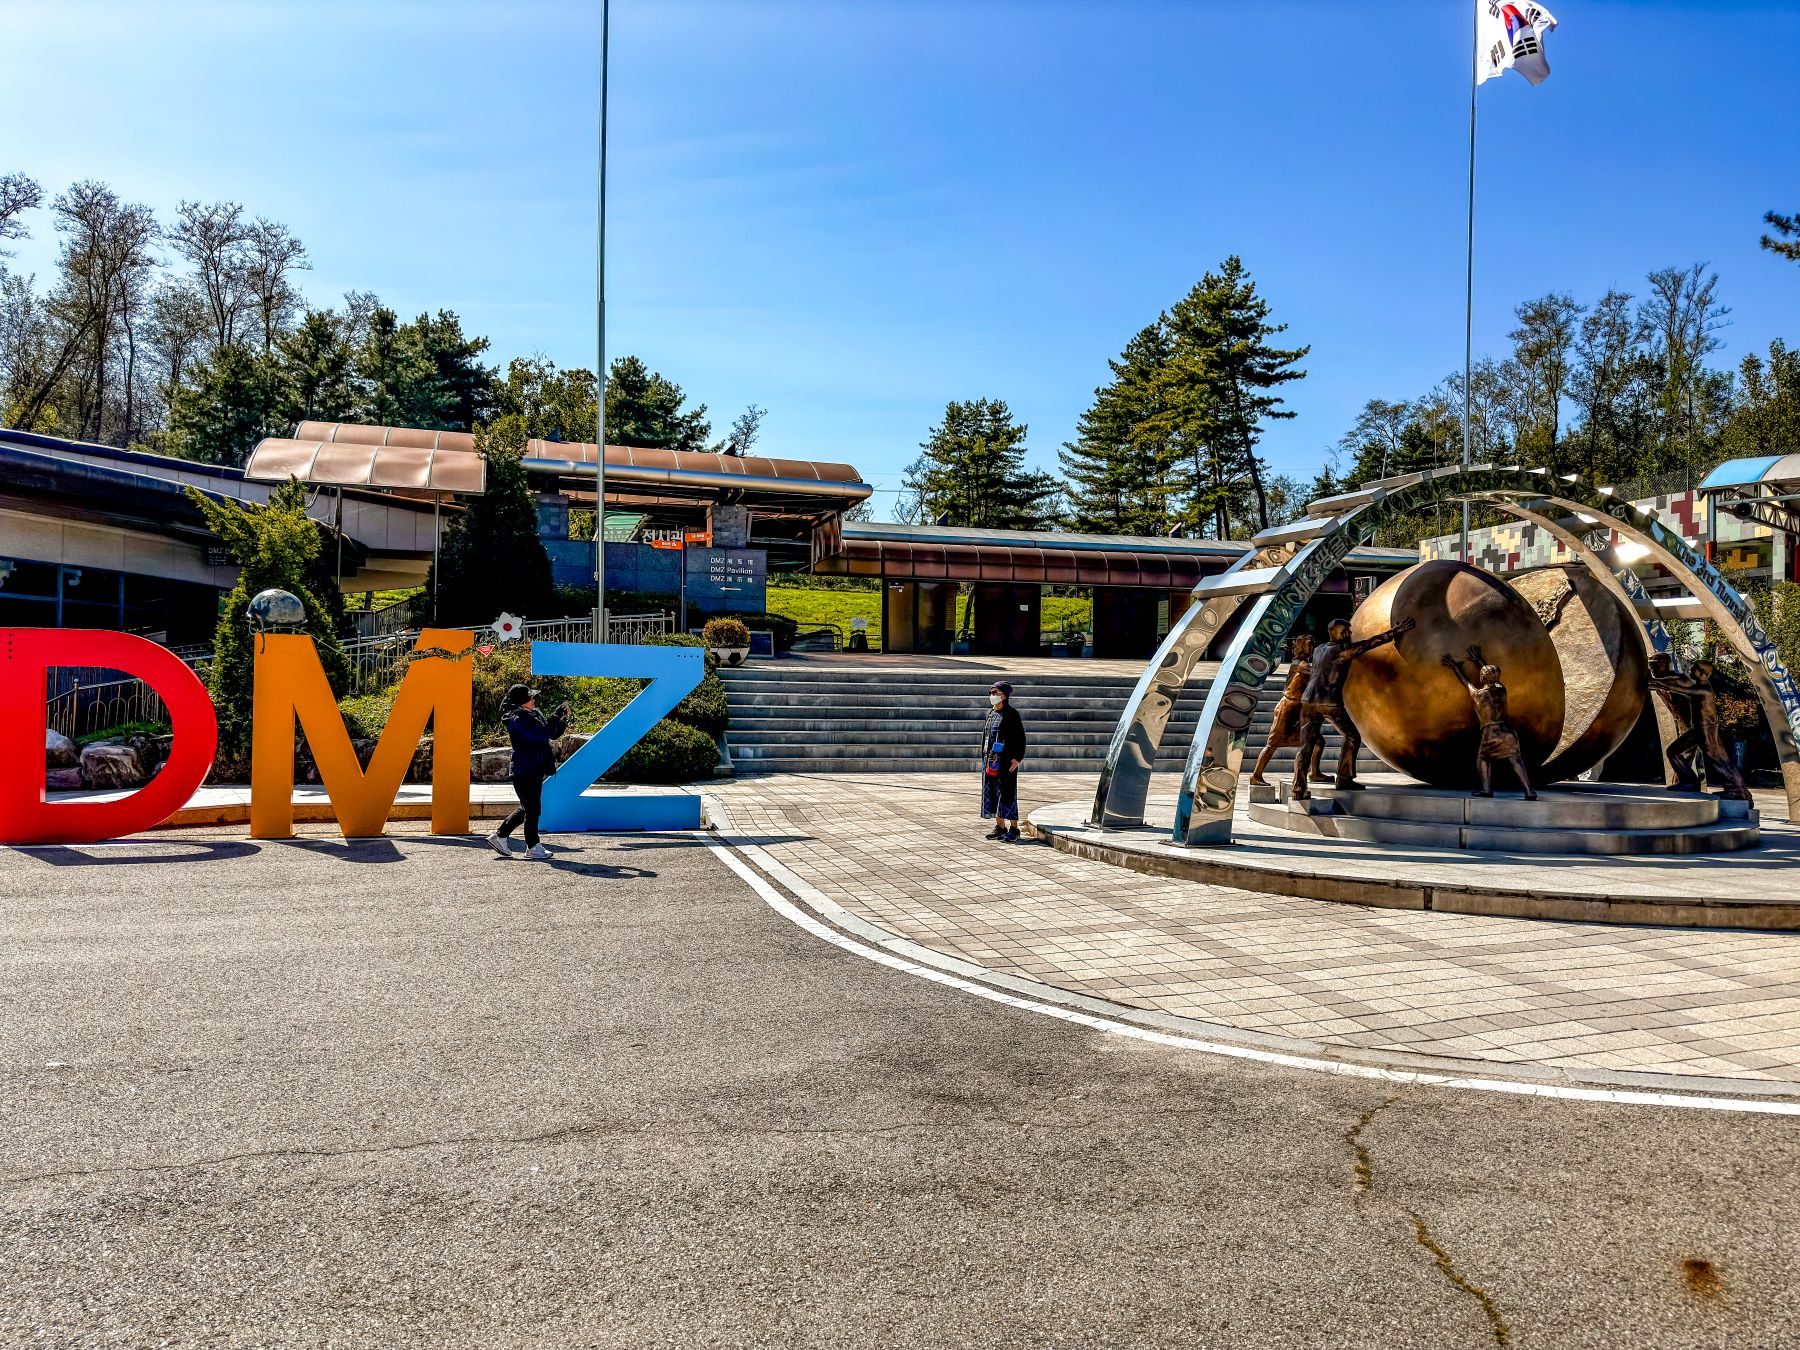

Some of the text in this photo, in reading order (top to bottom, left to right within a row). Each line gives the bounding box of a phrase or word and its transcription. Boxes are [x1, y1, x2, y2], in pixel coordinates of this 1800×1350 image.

[727, 567, 753, 575] Pavilion
[1675, 542, 1748, 623] The 3rd Tunnel
[0, 627, 704, 845] DMZ
